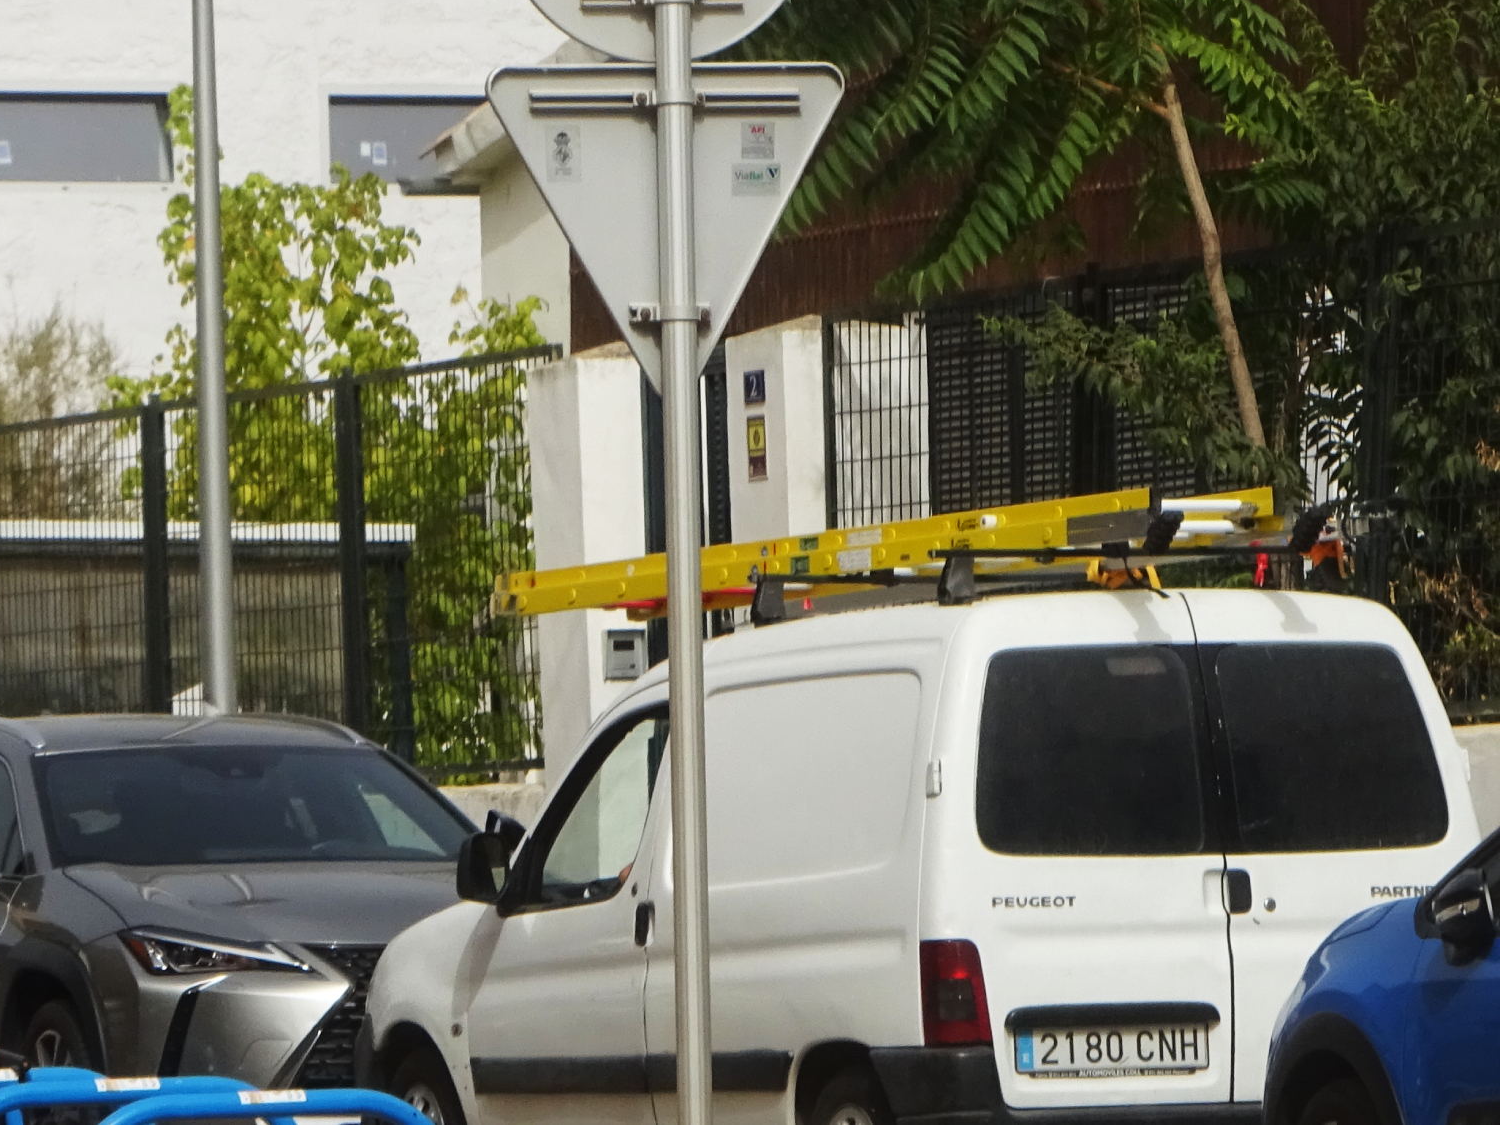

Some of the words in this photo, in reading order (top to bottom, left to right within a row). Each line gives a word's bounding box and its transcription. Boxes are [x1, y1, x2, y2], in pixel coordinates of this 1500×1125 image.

[749, 376, 758, 396] 2
[991, 896, 1077, 909] PEUGEOT
[1041, 1030, 1124, 1065] 2180
[1137, 1028, 1199, 1062] CNH
